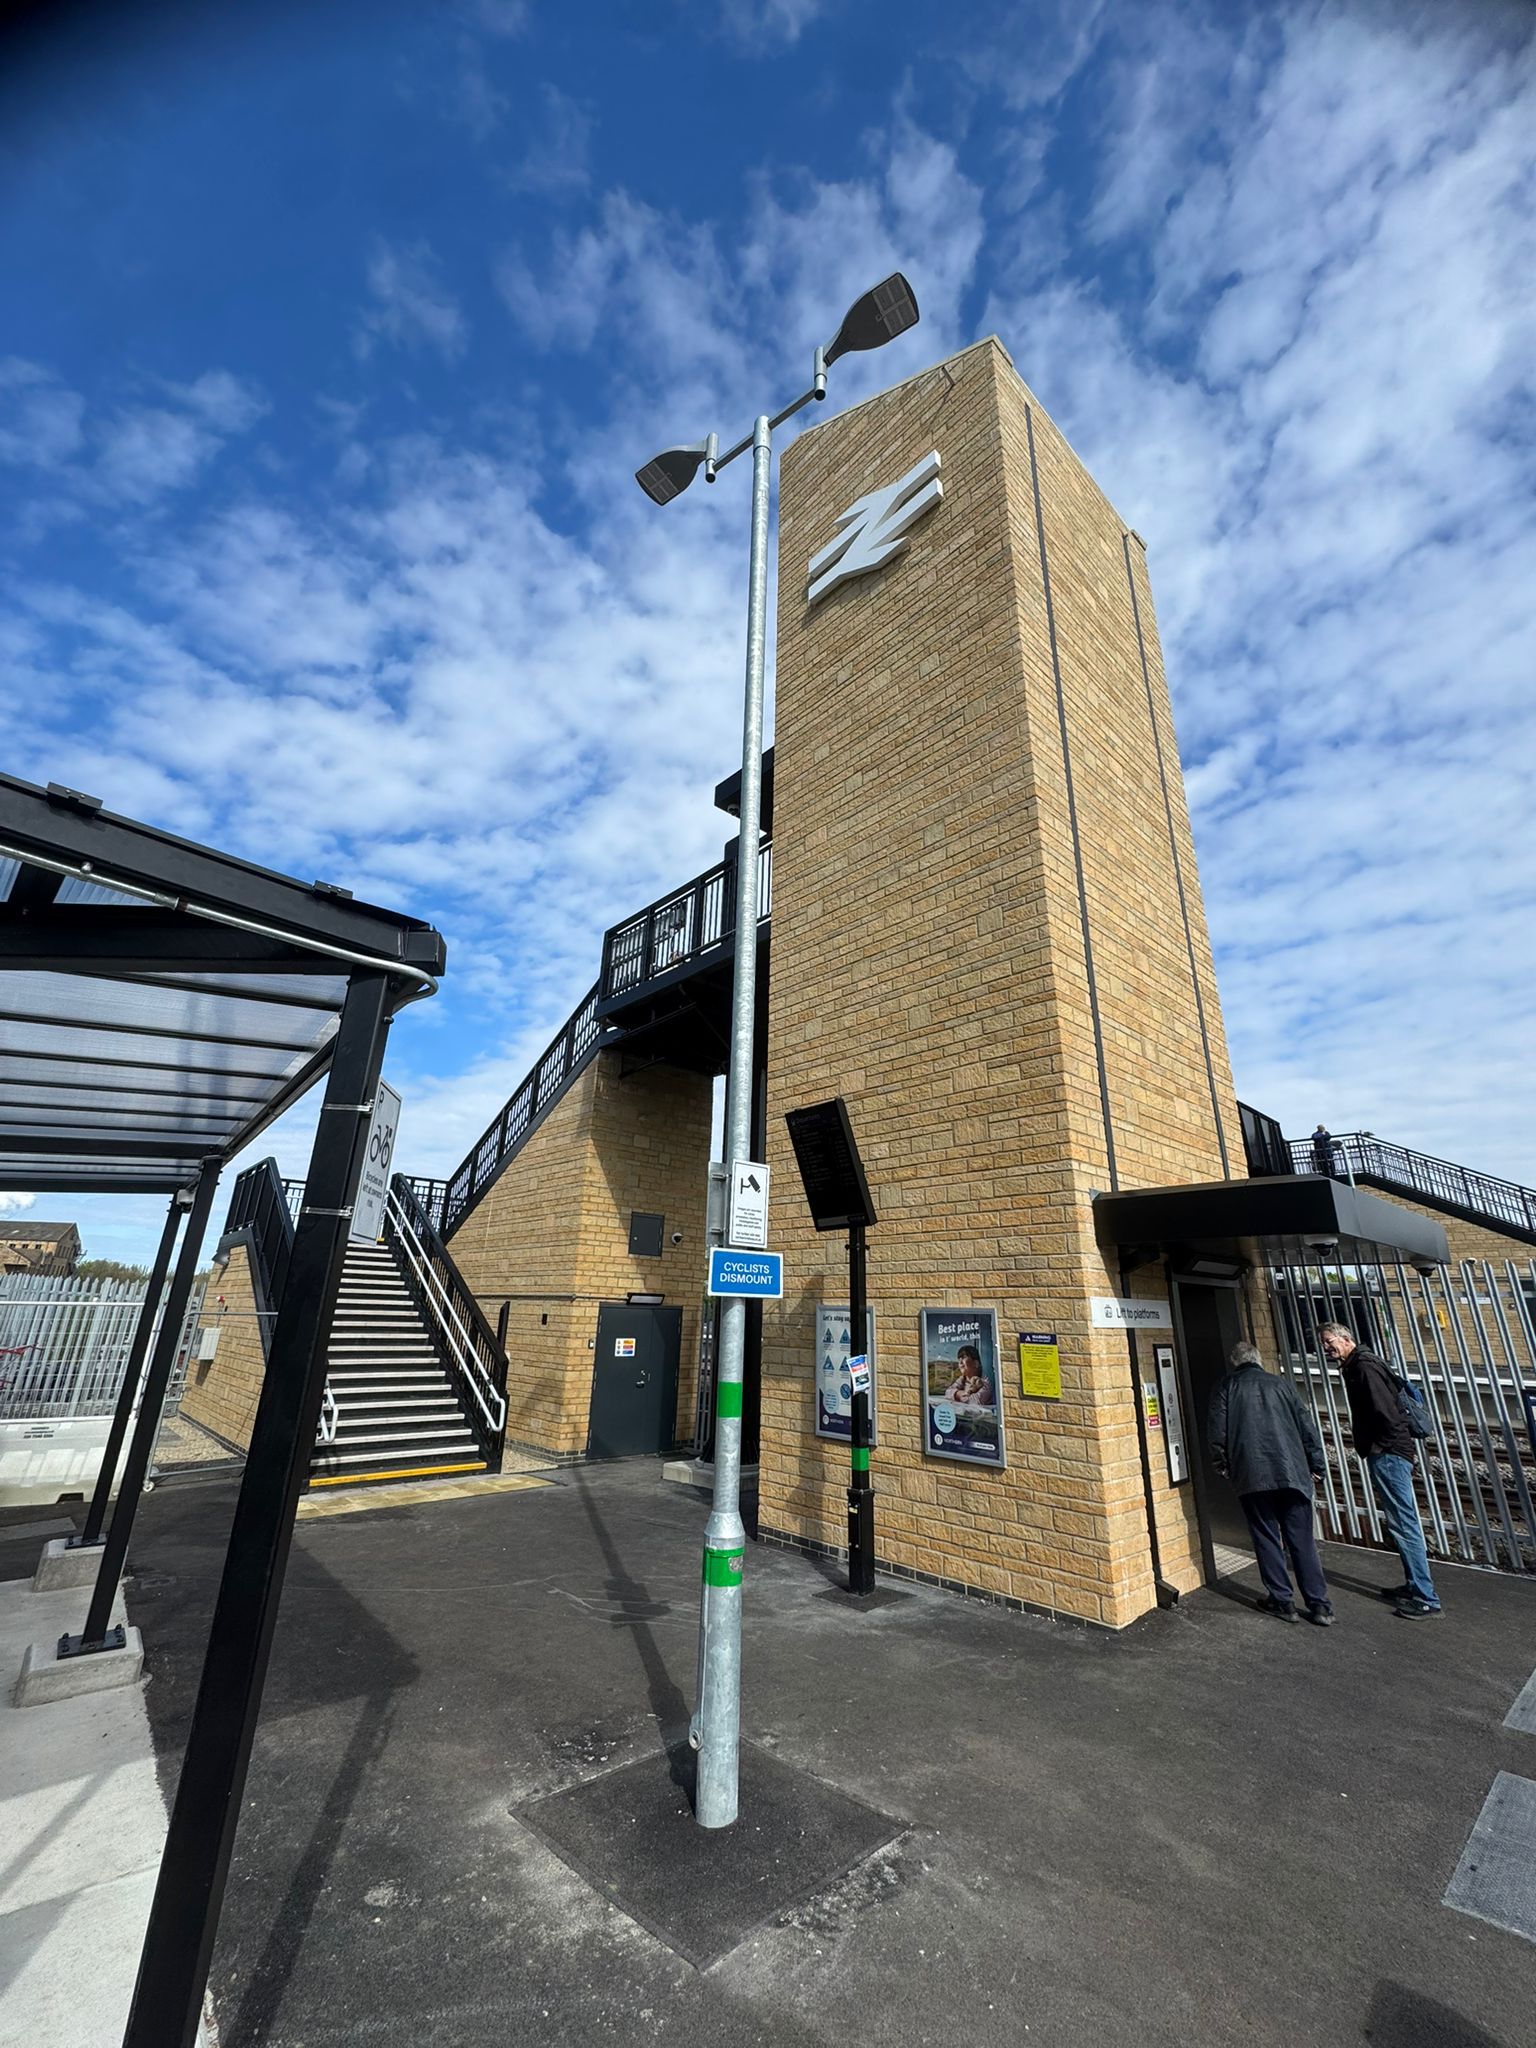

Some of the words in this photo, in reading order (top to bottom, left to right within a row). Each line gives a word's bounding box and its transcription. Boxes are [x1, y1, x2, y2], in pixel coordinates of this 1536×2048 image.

[378, 1091, 384, 1109] P
[723, 1261, 770, 1274] CYCLISTS
[719, 1272, 773, 1285] DISMOUNT
[1116, 1308, 1126, 1318] Lift
[1133, 1308, 1160, 1321] platforms
[938, 1323, 956, 1335] Best
[957, 1321, 980, 1335] place
